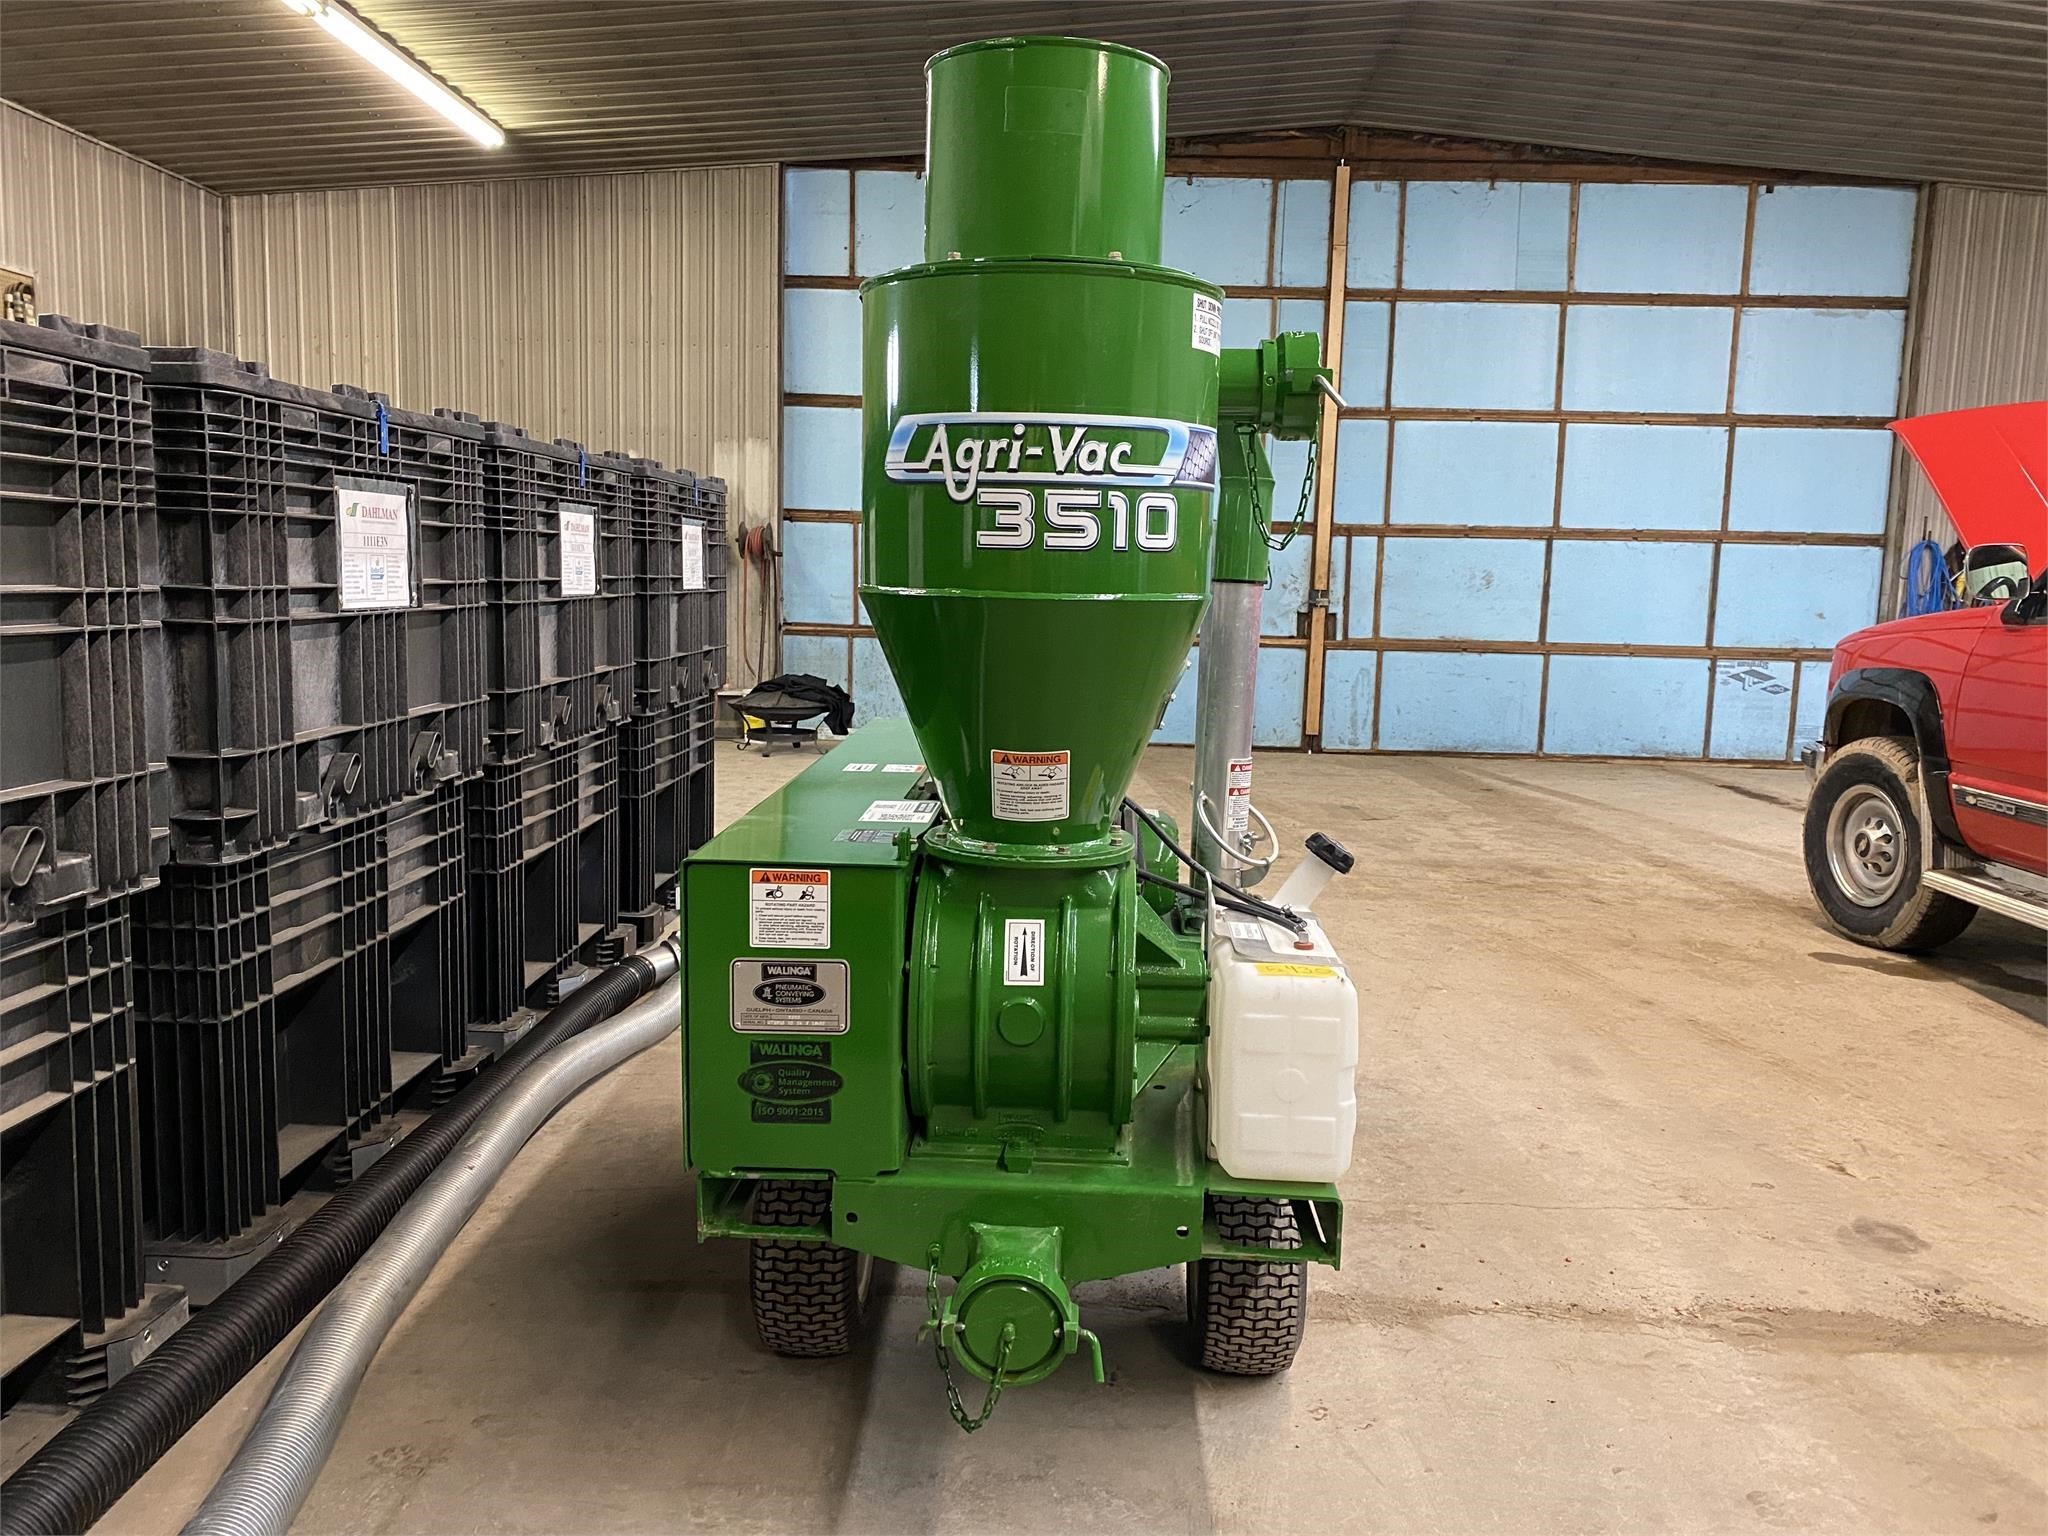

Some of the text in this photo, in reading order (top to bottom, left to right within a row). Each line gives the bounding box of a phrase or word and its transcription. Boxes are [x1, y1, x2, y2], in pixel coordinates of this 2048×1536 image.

[923, 422, 1133, 501] Agri-Vac
[361, 506, 398, 521] DAHLMAN
[976, 487, 1178, 551] 3510
[1012, 754, 1061, 764] WARNING
[1977, 797, 2016, 816] 2500
[772, 872, 821, 883] WARNING
[767, 966, 812, 976] WALINGA
[760, 1043, 822, 1056] WALINGA
[778, 1068, 811, 1077] Quality
[778, 1078, 836, 1087] Management
[778, 1087, 811, 1096] System
[758, 1107, 824, 1117] ISO 9001:2015
